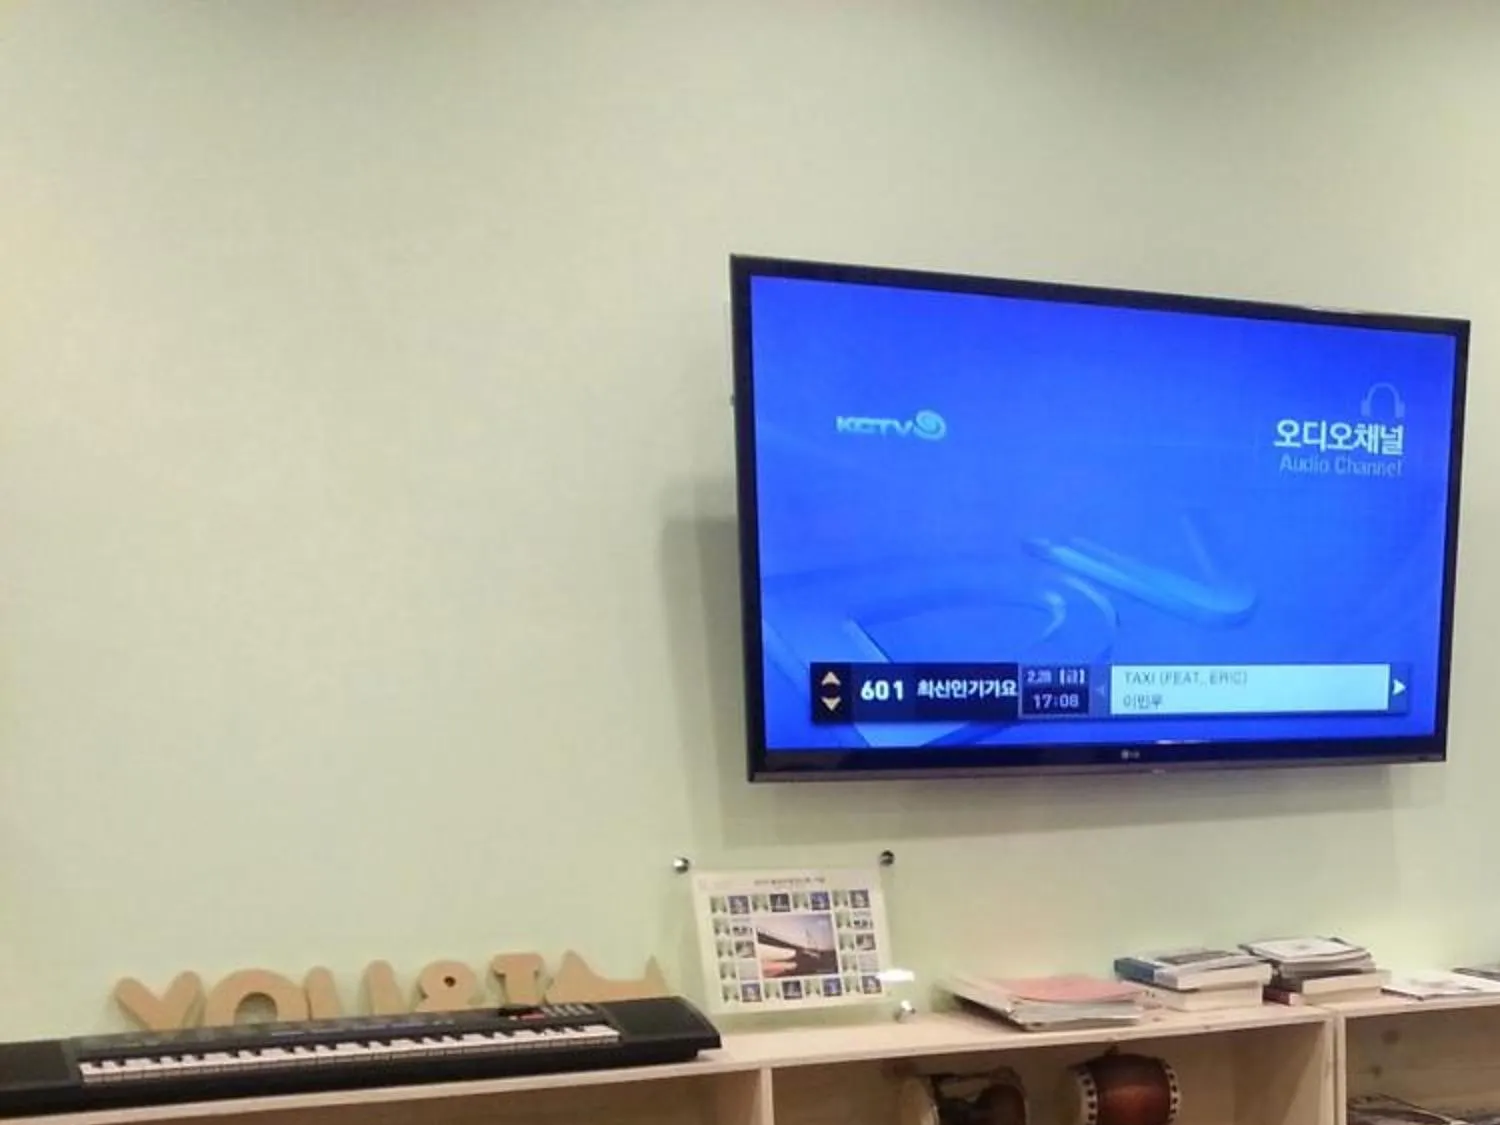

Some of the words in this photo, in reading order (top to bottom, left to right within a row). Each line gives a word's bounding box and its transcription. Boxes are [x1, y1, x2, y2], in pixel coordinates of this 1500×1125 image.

[1273, 418, 1404, 456] 오디오채널
[1279, 452, 1330, 475] Audio
[1334, 455, 1403, 478] Channel
[1124, 671, 1155, 685] TAXI
[860, 680, 904, 701] 601
[1033, 693, 1079, 709] 17:08
